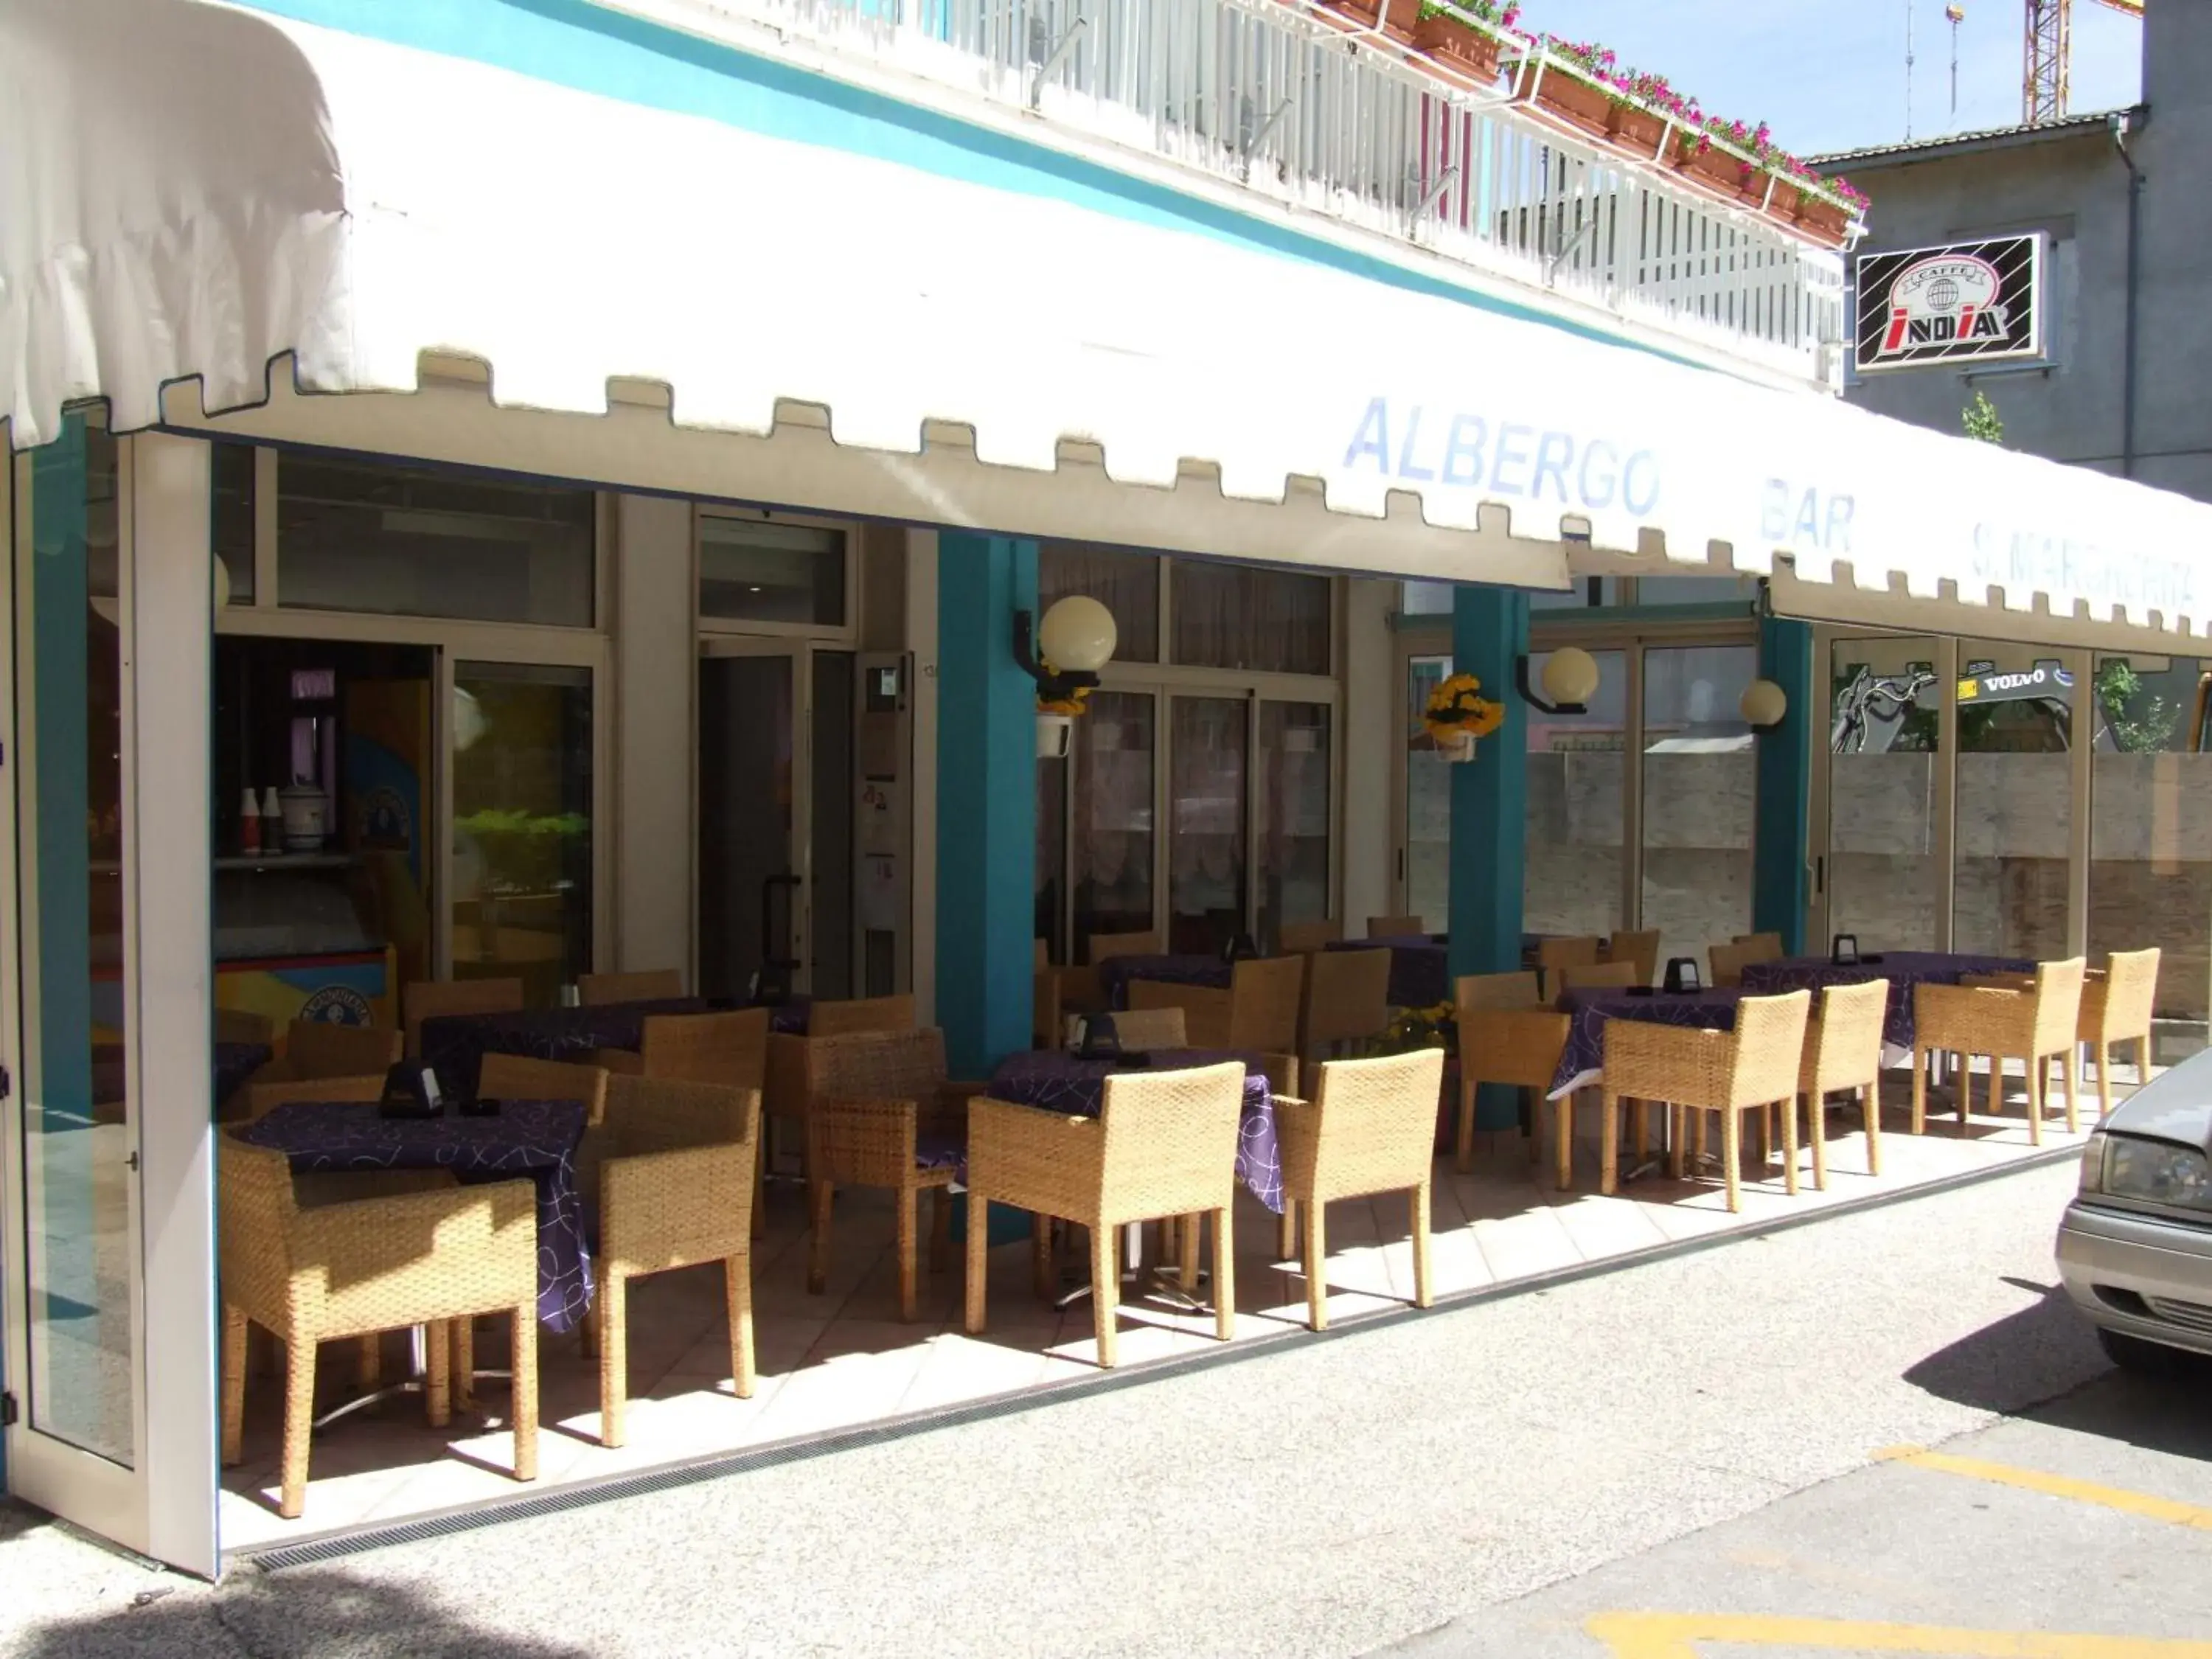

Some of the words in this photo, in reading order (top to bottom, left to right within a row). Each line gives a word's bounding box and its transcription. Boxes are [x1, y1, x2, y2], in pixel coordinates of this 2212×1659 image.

[1342, 395, 1661, 517] ALBERGO
[1760, 477, 1856, 552] BAR
[1983, 669, 2045, 692] VOLVO
